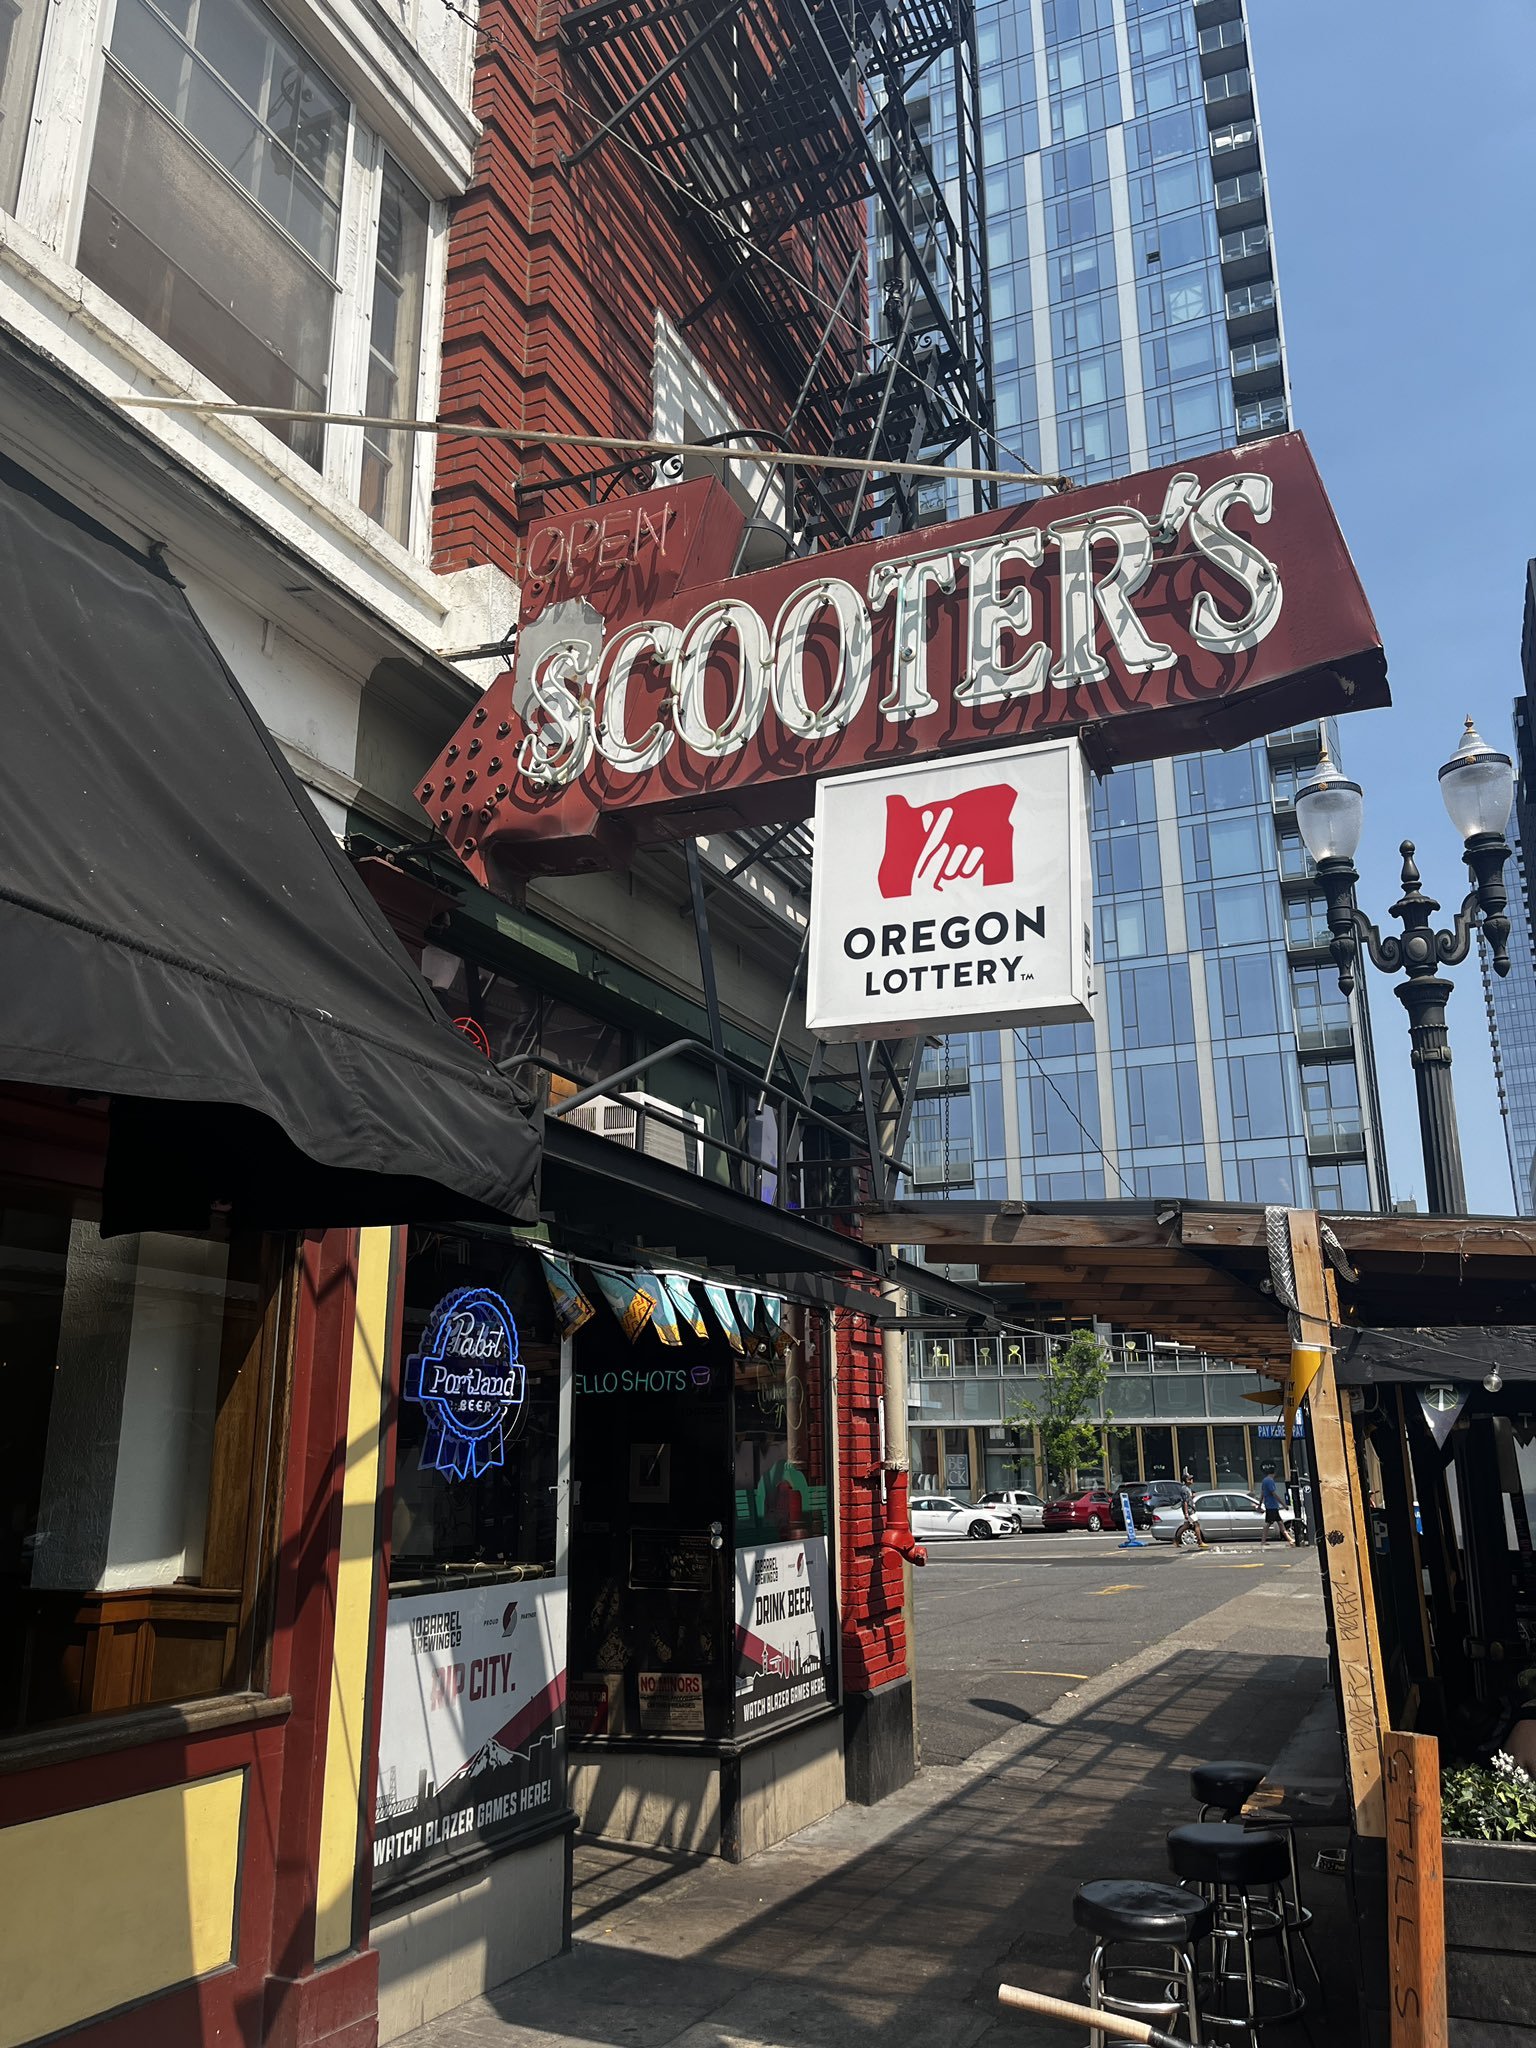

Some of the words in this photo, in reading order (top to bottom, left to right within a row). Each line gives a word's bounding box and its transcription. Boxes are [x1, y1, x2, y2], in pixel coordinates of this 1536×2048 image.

[527, 501, 669, 583] OPEN
[517, 472, 1283, 787] SCOOTER'S
[843, 905, 1046, 960] OREGON
[865, 955, 1023, 997] LOTTERY
[450, 1311, 505, 1358] Pabst
[429, 1365, 516, 1396] Portland
[575, 1372, 618, 1394] ELLO
[621, 1369, 687, 1393] SHOTS
[458, 1400, 492, 1412] BEER
[1258, 1425, 1270, 1437] PAY
[483, 1618, 499, 1626] PROUD
[756, 1591, 786, 1626] DRINK
[469, 1652, 516, 1702] CITY.
[640, 1677, 656, 1692] NO
[658, 1677, 699, 1692] MINORS
[743, 1699, 766, 1722] WATCH
[766, 1690, 790, 1714] BLAZER
[790, 1681, 810, 1704] GAMES
[373, 1825, 422, 1867] WATCH
[425, 1807, 474, 1846] BLAZER
[477, 1792, 518, 1827] GAMES
[520, 1779, 551, 1810] HERE!
